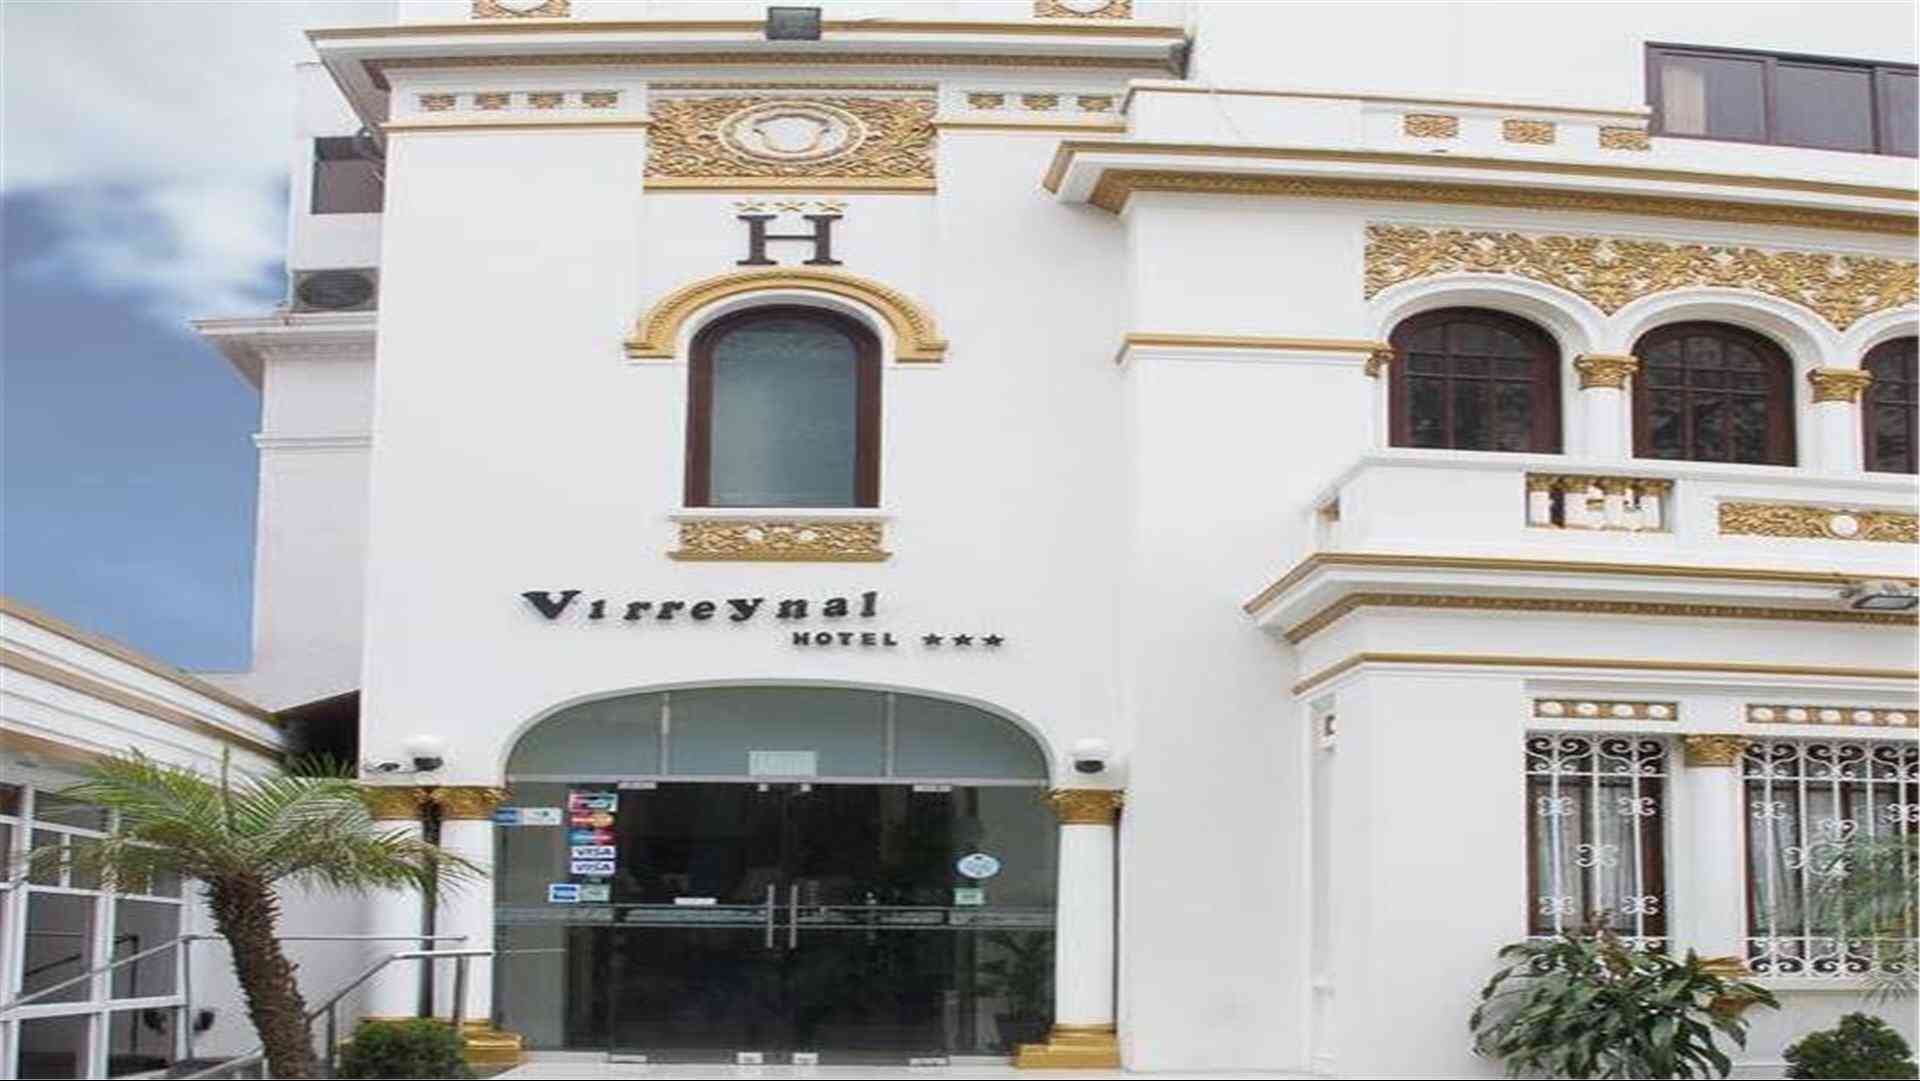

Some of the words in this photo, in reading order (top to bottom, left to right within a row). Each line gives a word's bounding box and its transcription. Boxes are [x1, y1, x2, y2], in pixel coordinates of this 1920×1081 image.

[737, 214, 843, 266] H
[521, 590, 878, 623] Virreynal
[792, 631, 898, 647] HOTEL
[574, 847, 612, 857] VISA
[574, 862, 611, 871] VISA
